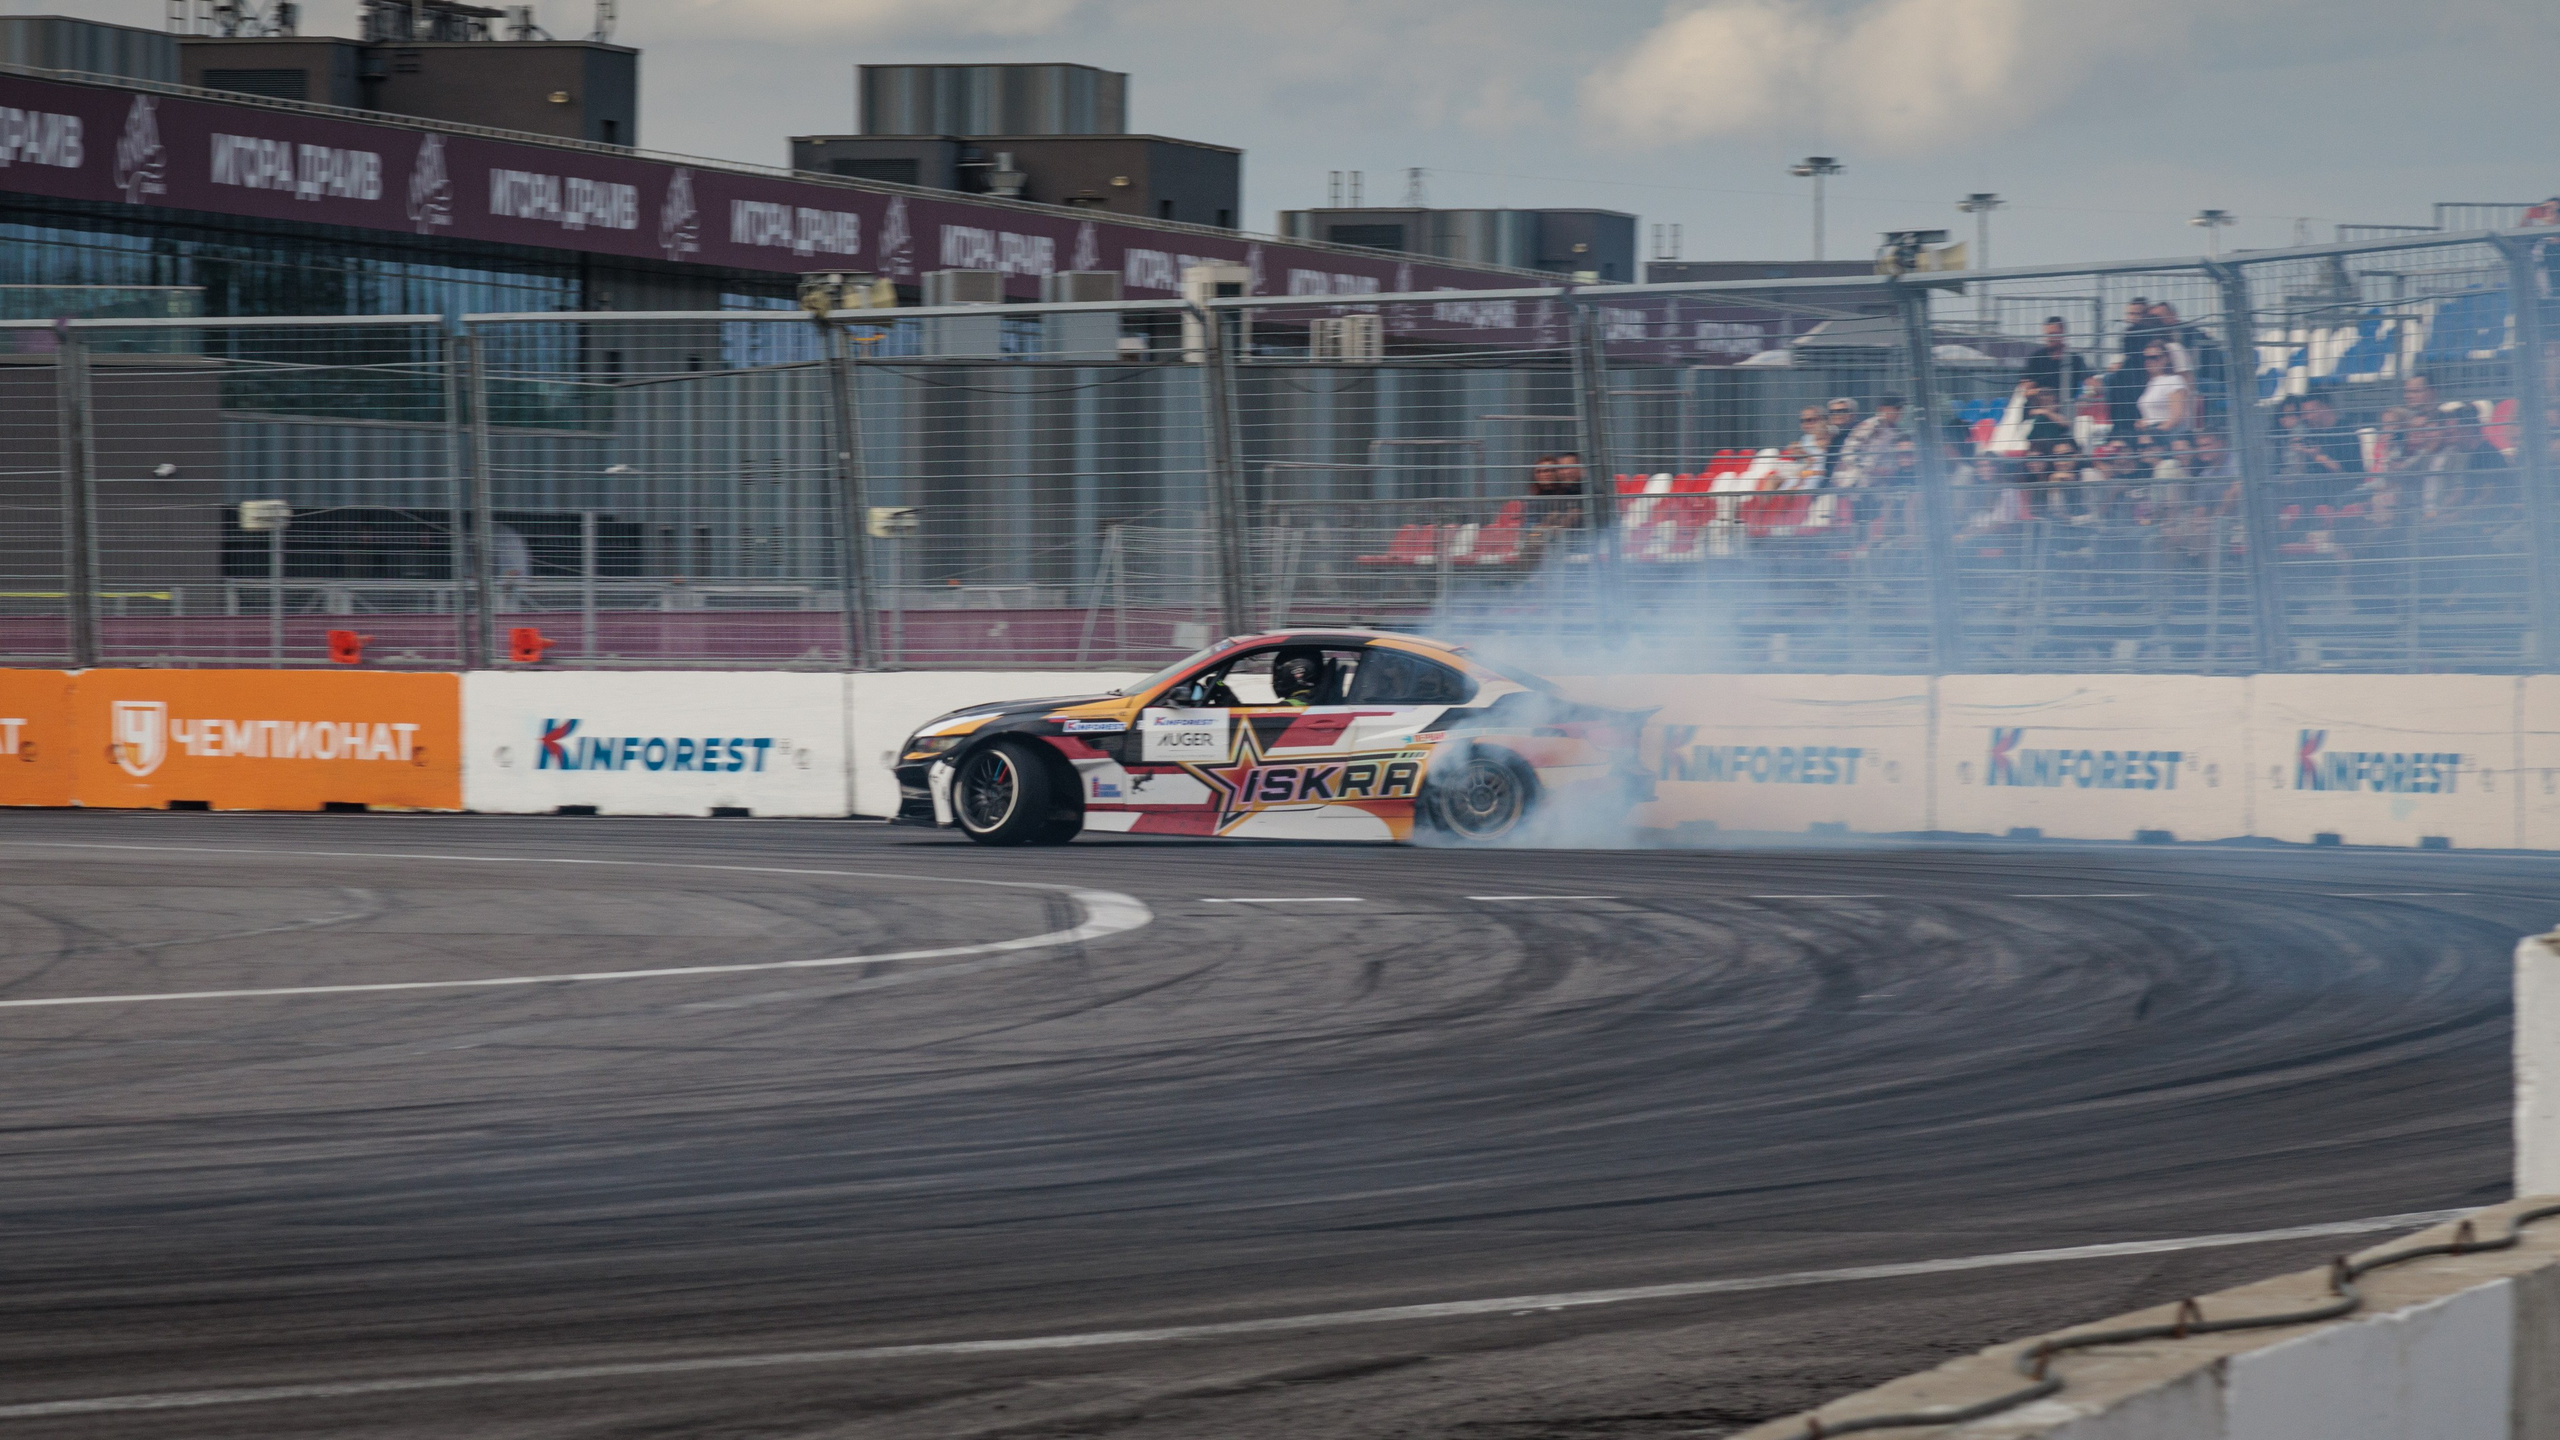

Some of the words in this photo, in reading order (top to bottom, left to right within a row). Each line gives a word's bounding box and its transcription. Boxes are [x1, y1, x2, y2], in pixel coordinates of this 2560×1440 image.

[170, 719, 420, 761] ЧЕМПИОНАТ
[535, 718, 777, 773] KINFOREST
[1157, 733, 1214, 747] AUGER
[1660, 724, 1864, 785] KINFOREST
[1986, 728, 2184, 790] KINFOREST
[2294, 729, 2463, 793] KINFOREST
[1240, 761, 1421, 803] ISKRA
